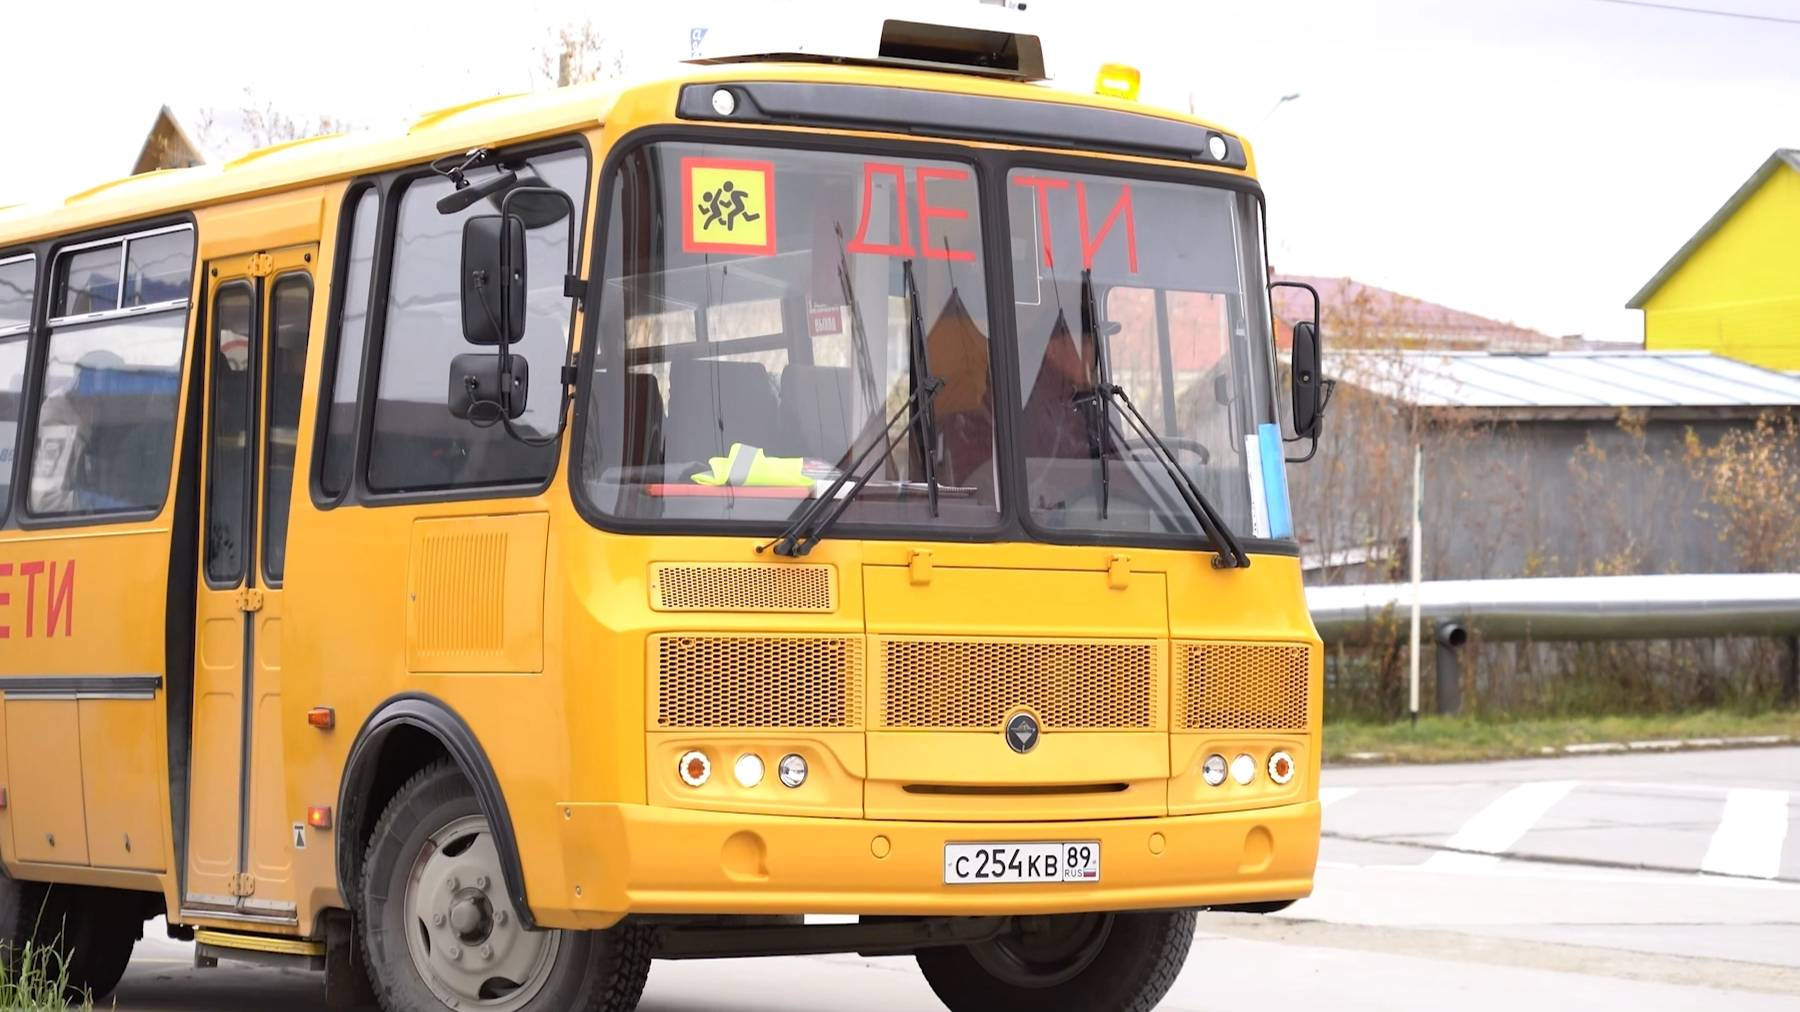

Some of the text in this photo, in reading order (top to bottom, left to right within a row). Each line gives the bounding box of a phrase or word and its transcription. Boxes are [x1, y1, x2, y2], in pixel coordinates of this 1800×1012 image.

[847, 162, 1138, 274] ДЕТИ
[1067, 846, 1091, 868] 89
[1064, 869, 1083, 878] RUS
